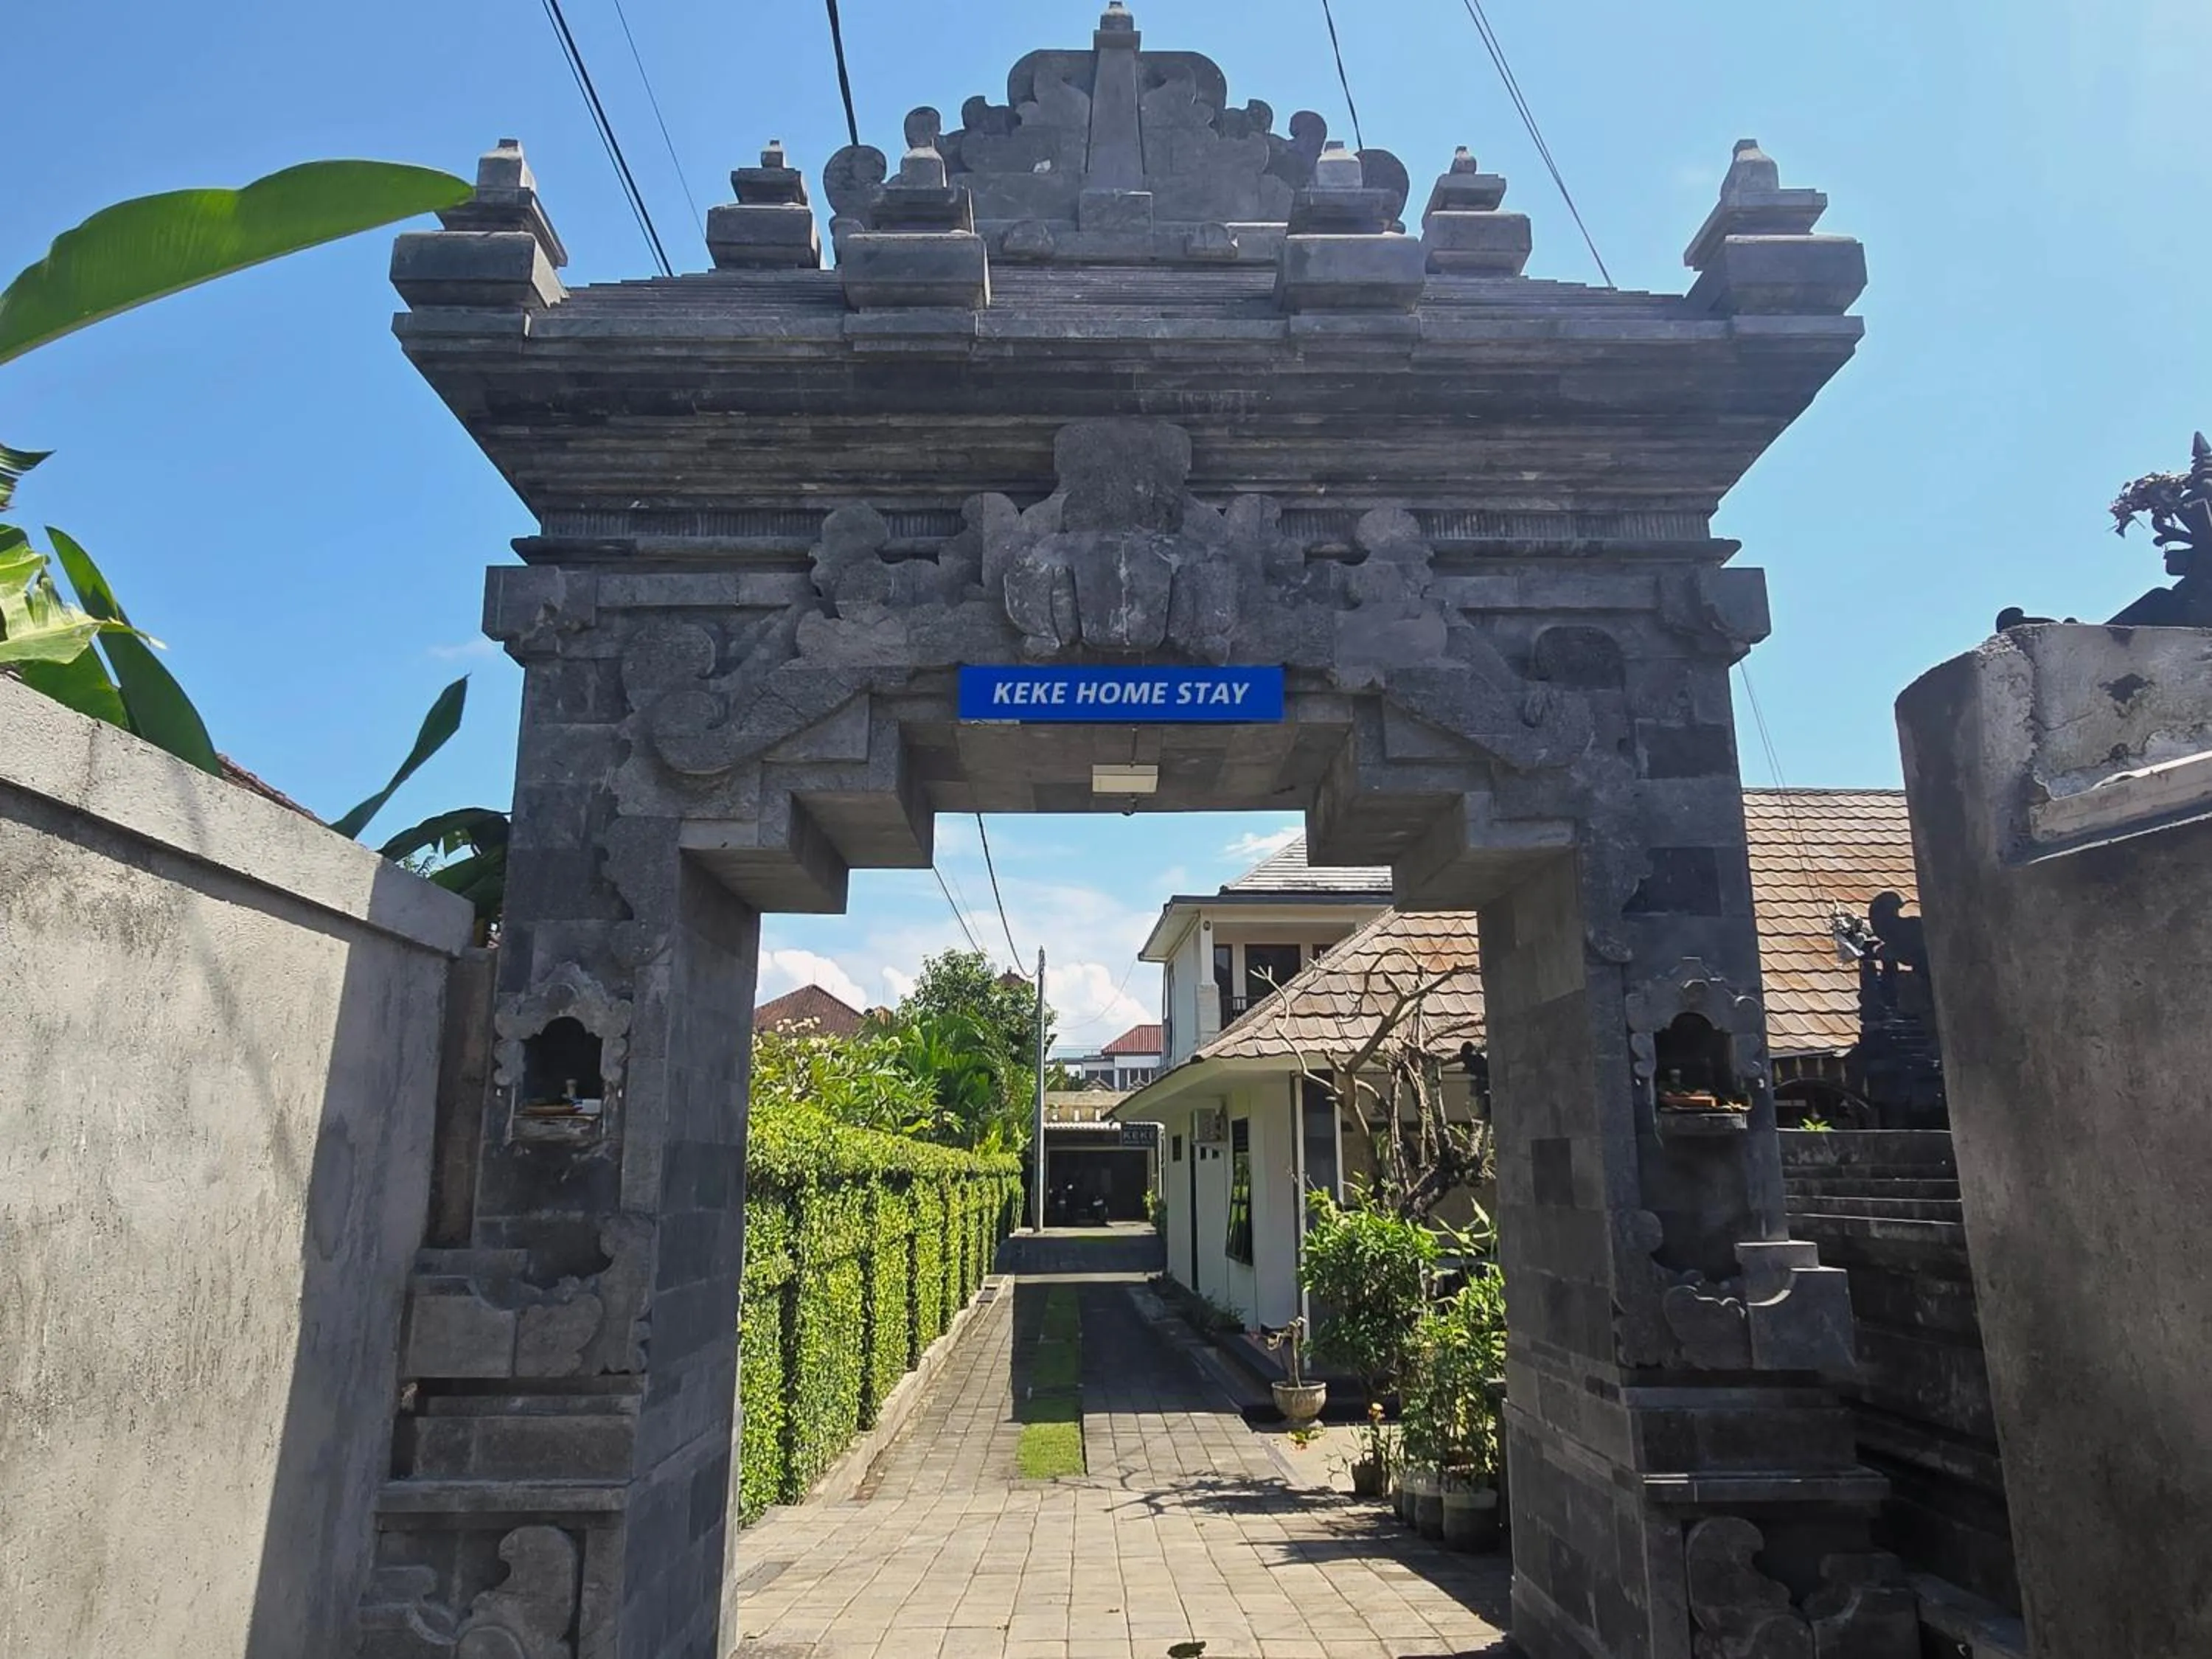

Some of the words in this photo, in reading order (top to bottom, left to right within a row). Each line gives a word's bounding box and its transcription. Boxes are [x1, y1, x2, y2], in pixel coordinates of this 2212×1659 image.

[992, 682, 1068, 704] KEKE
[1077, 682, 1168, 704] HOME
[1176, 682, 1251, 704] STAY
